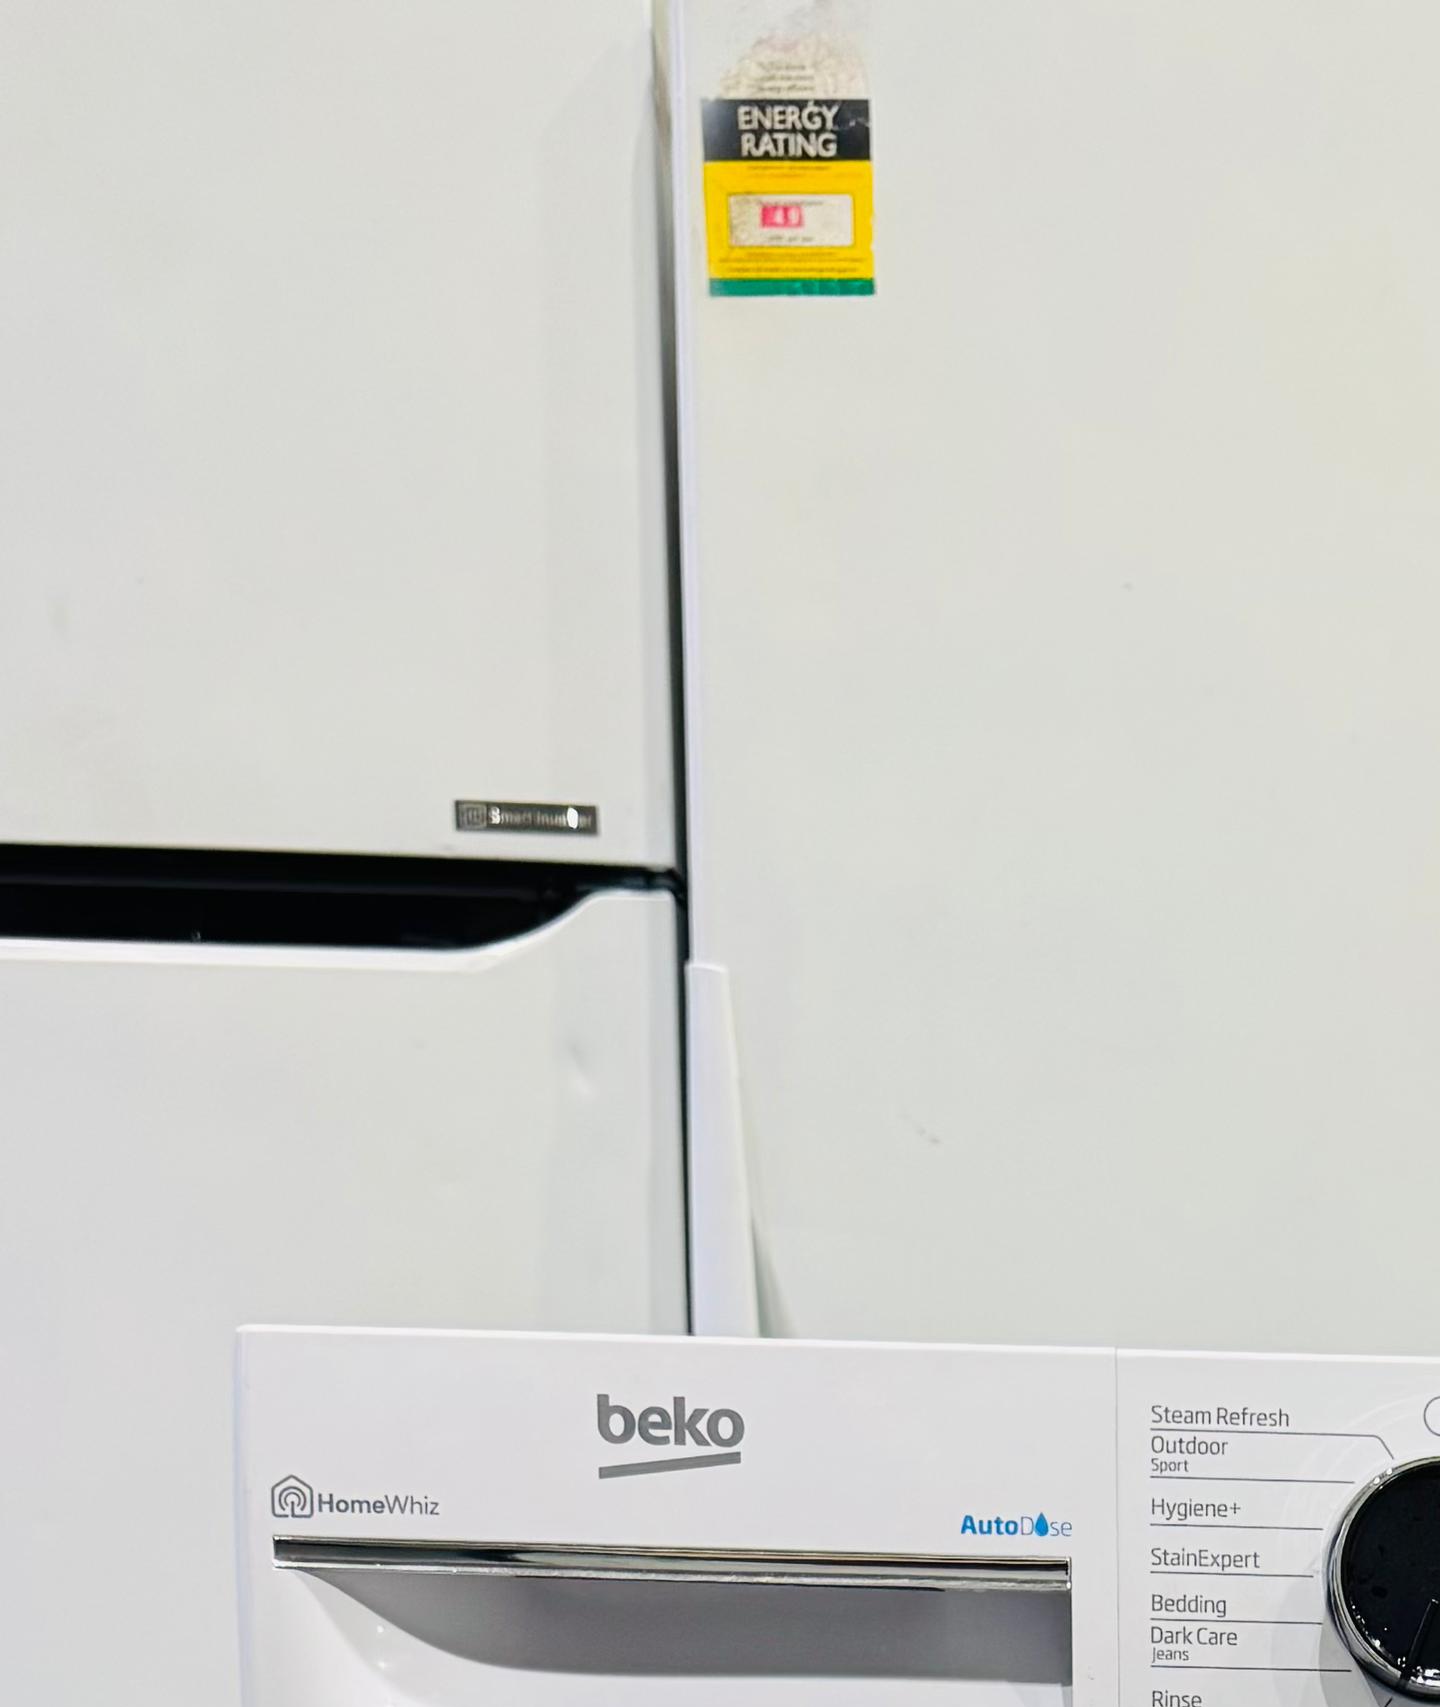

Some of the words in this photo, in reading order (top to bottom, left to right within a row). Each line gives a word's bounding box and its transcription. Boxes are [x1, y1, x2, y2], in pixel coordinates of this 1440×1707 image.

[737, 104, 839, 131] ENERGY
[741, 132, 837, 157] RATING
[597, 1394, 745, 1447] beko
[1151, 1405, 1212, 1424] Steam
[1217, 1407, 1290, 1427] Refresh
[1151, 1436, 1228, 1455] Outdoor
[1151, 1458, 1189, 1474] Sport
[318, 1493, 439, 1516] HomeWhiz
[1151, 1498, 1241, 1521] Hygiene+
[1151, 1548, 1260, 1571] StainExpert
[1151, 1594, 1227, 1617] Bedding
[1150, 1627, 1192, 1644] Dark
[1197, 1628, 1238, 1646] Care
[1152, 1648, 1189, 1663] Jeans
